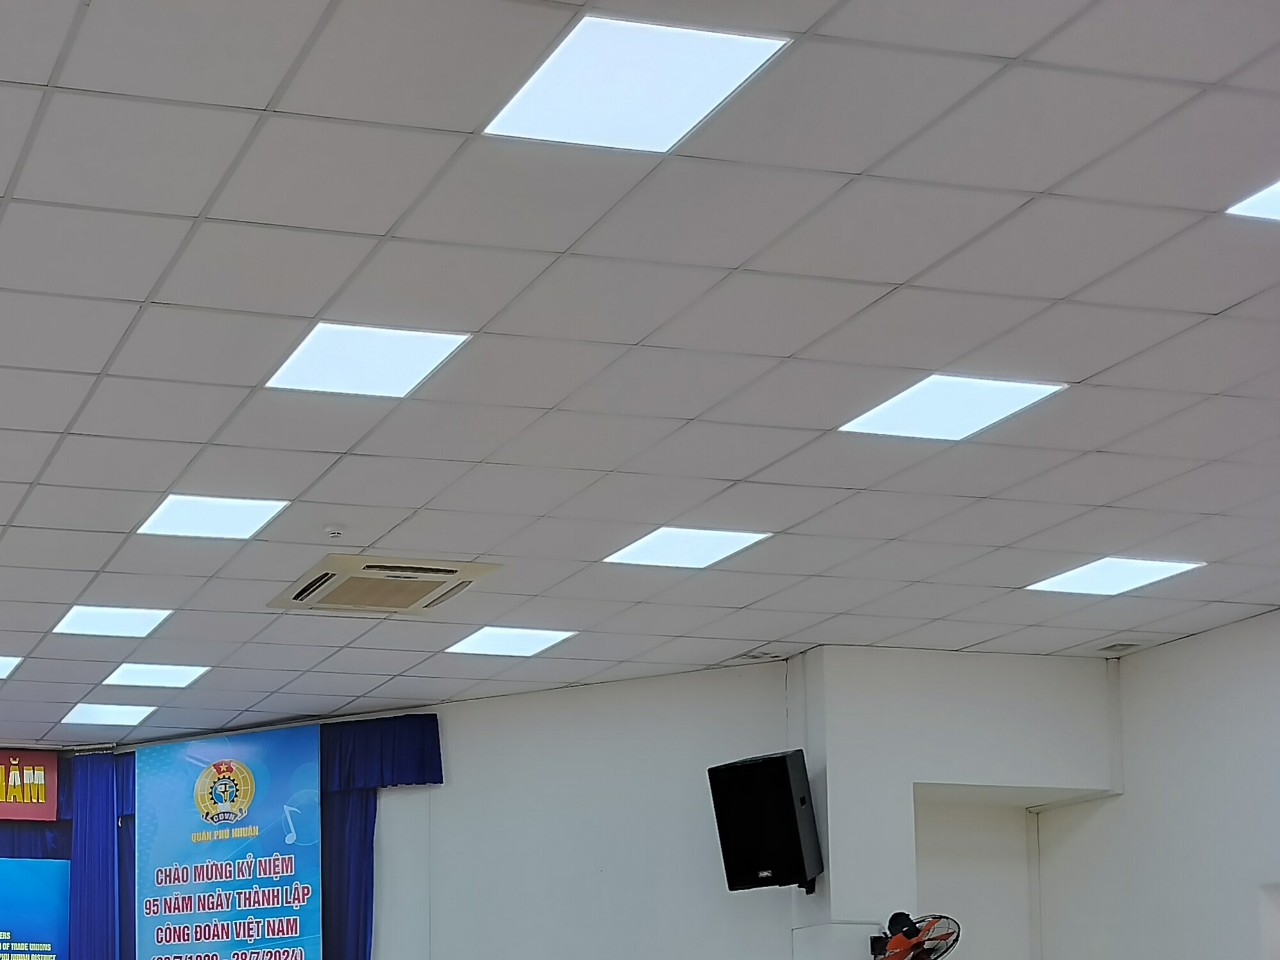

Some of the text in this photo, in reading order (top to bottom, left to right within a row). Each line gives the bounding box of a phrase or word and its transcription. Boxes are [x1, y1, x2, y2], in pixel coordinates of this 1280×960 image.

[155, 852, 294, 886] CHÀO MỪNG KỶ NIỆM
[144, 881, 311, 916] 95 NĂM NGÀY THÀNH LẬP
[155, 916, 299, 945] CÔNG ĐOÀN VIỆT NAM
